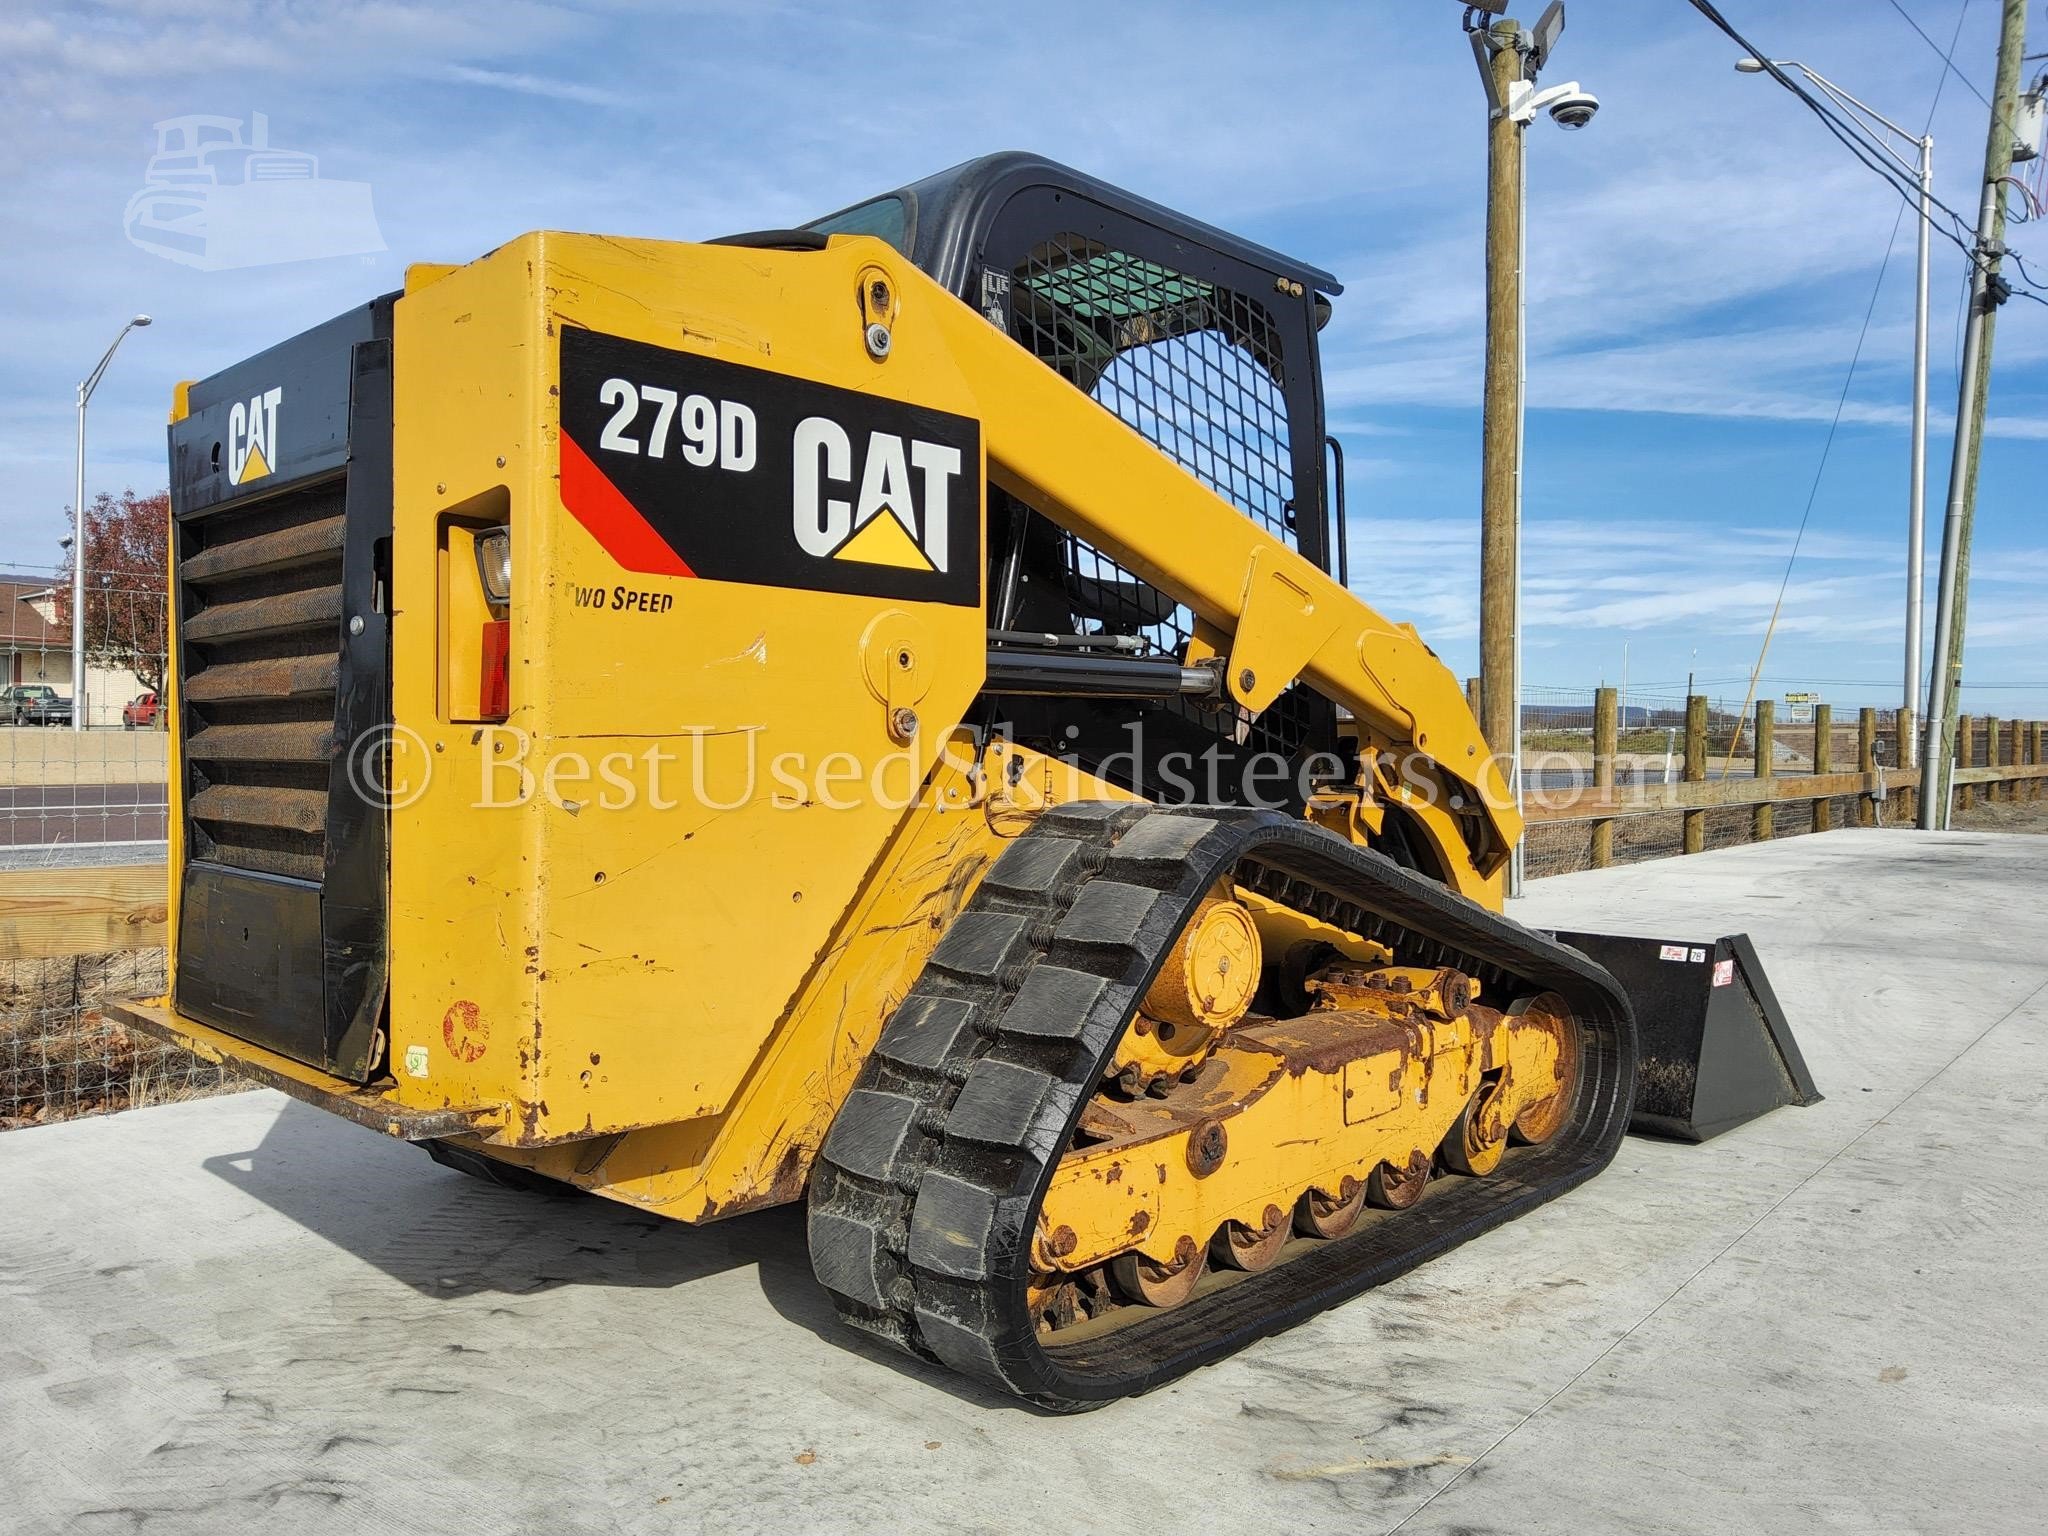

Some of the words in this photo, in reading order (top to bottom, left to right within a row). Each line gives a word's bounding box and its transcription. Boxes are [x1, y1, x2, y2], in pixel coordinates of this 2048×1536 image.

[228, 386, 282, 486] CAT
[600, 378, 756, 472] 279D
[793, 416, 961, 573] CAT
